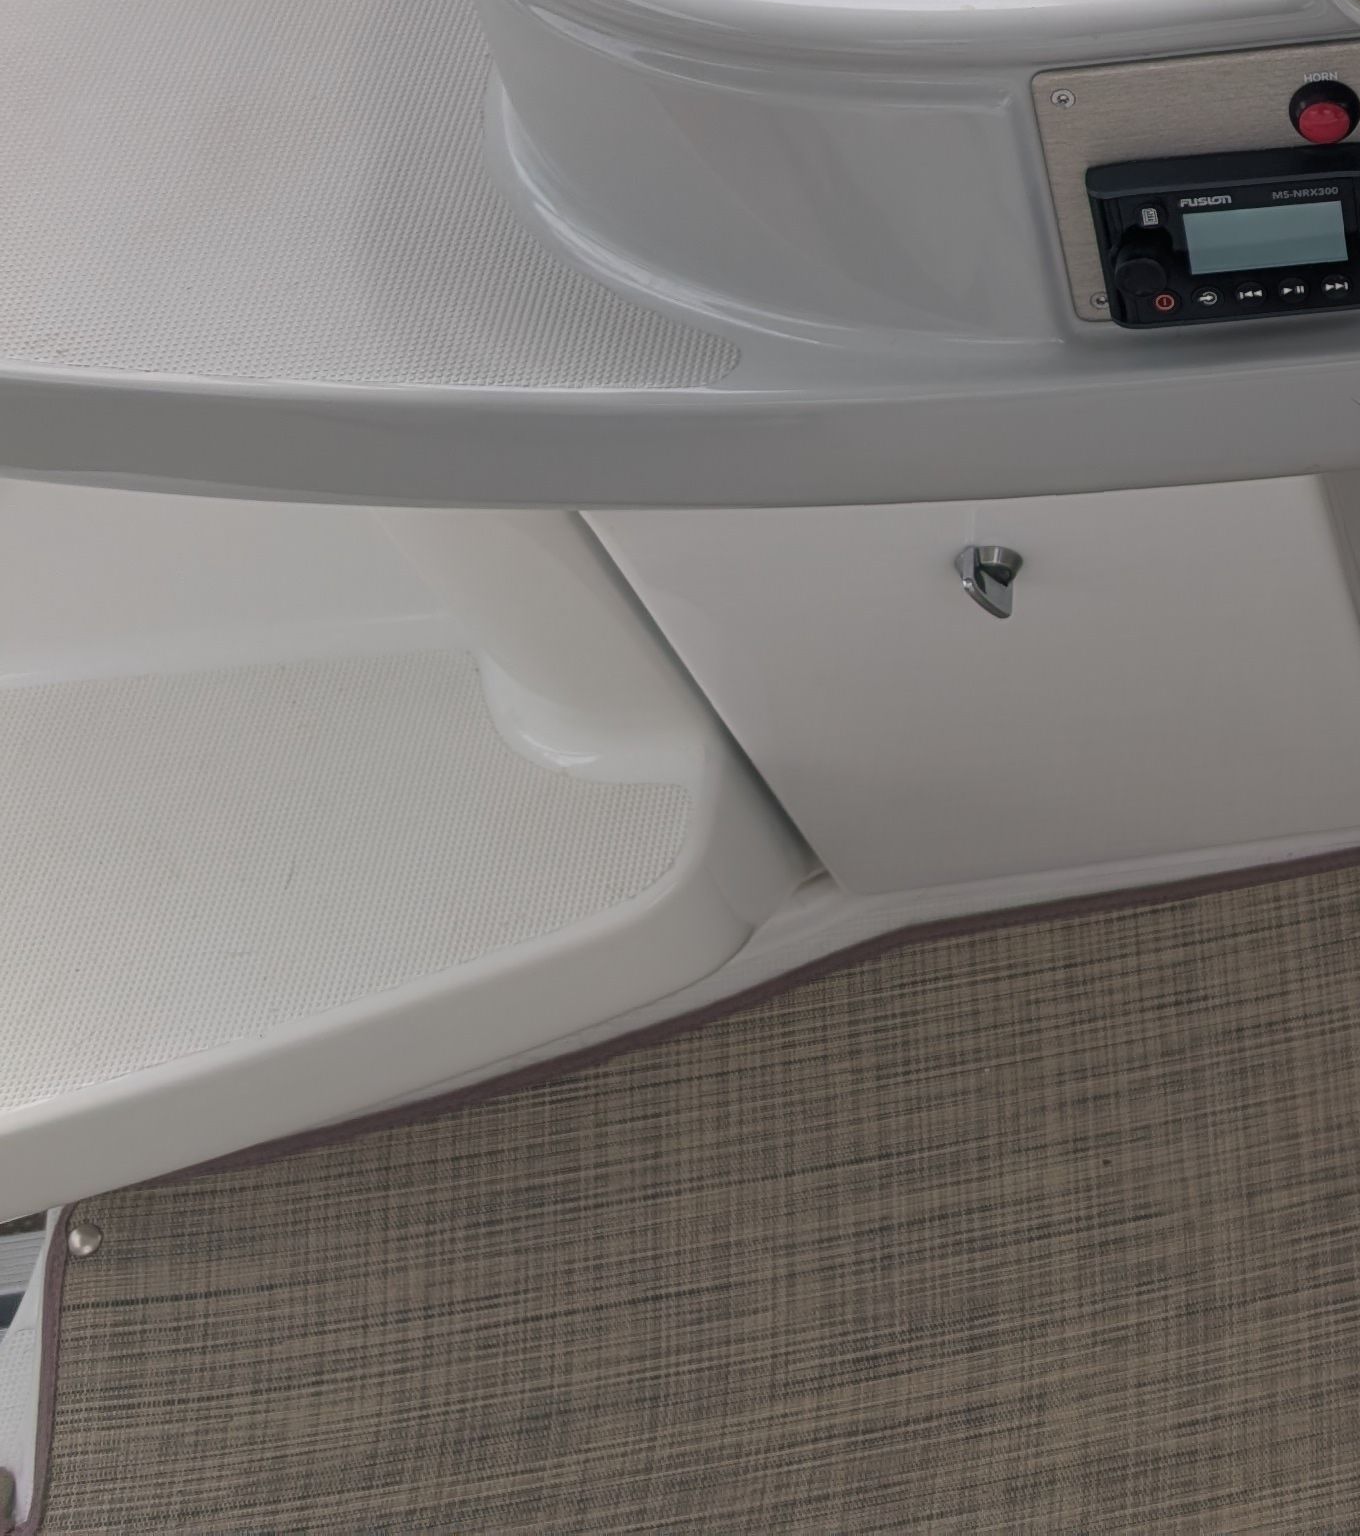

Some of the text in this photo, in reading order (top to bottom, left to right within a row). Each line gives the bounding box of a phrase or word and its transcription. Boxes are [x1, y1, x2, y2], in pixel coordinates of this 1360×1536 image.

[1303, 70, 1338, 83] HORN
[1271, 185, 1340, 201] MS-NRX300
[1179, 194, 1232, 208] FUSION
